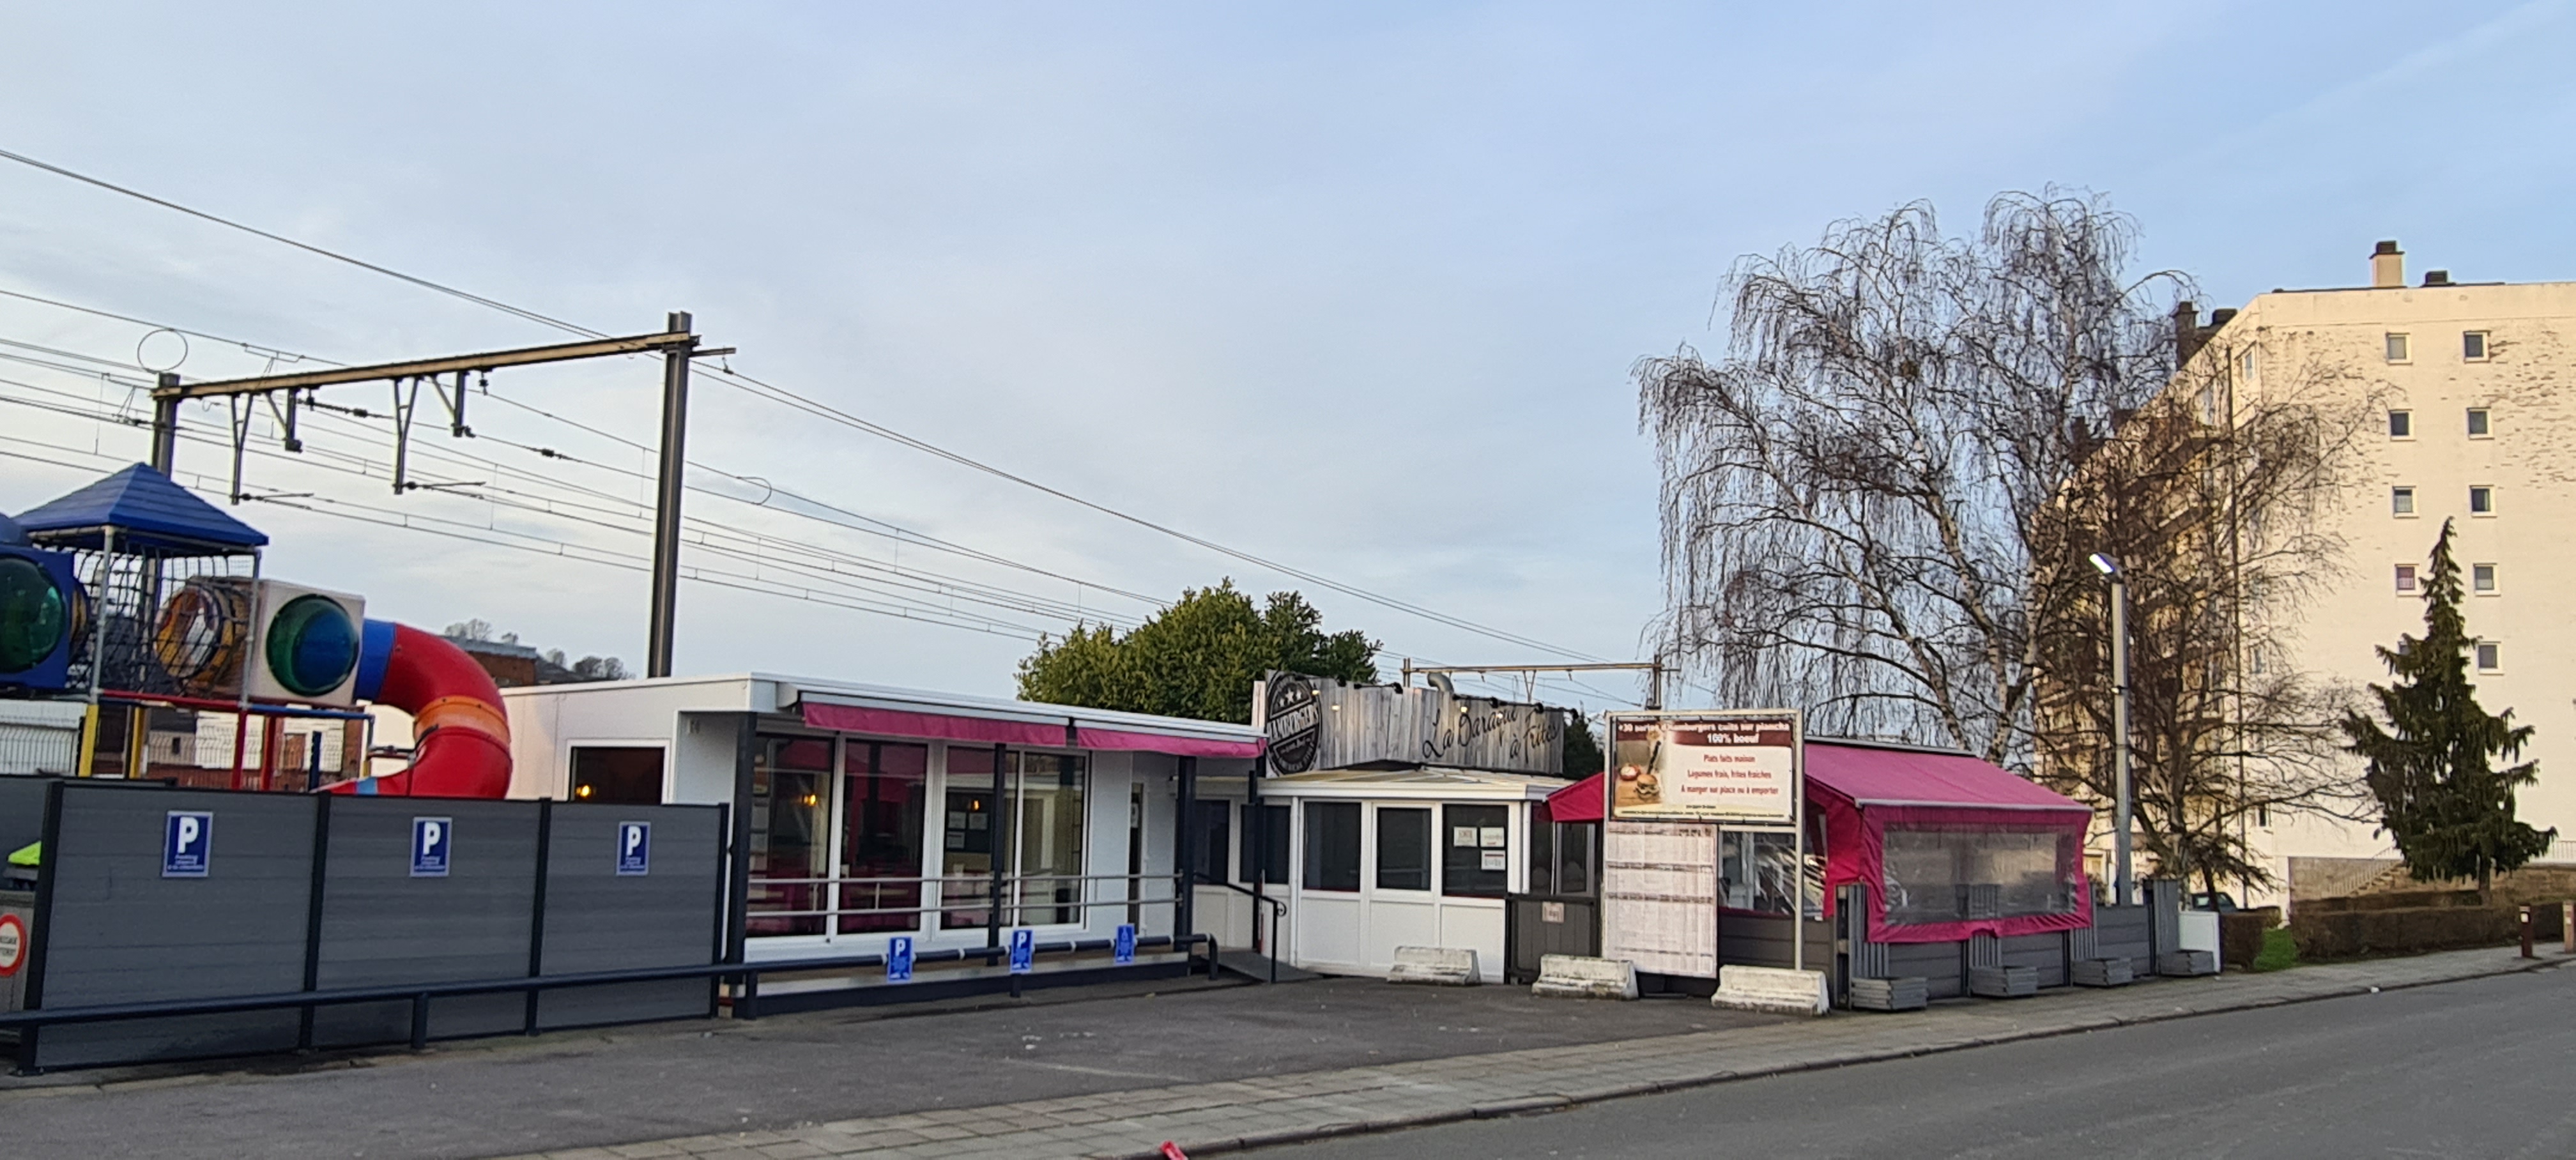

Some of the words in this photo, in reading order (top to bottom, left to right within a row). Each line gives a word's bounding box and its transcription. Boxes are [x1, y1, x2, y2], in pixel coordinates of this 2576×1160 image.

[1422, 708, 1454, 759] La
[1707, 733, 1732, 744] 100%
[1703, 754, 1719, 763] Plats
[1734, 754, 1756, 763] maison
[1687, 786, 1708, 795] manger
[1751, 786, 1779, 795] emporter
[178, 817, 199, 853] P
[423, 822, 441, 855] P
[627, 826, 641, 856] P
[895, 939, 906, 957] P
[1017, 932, 1027, 948] P
